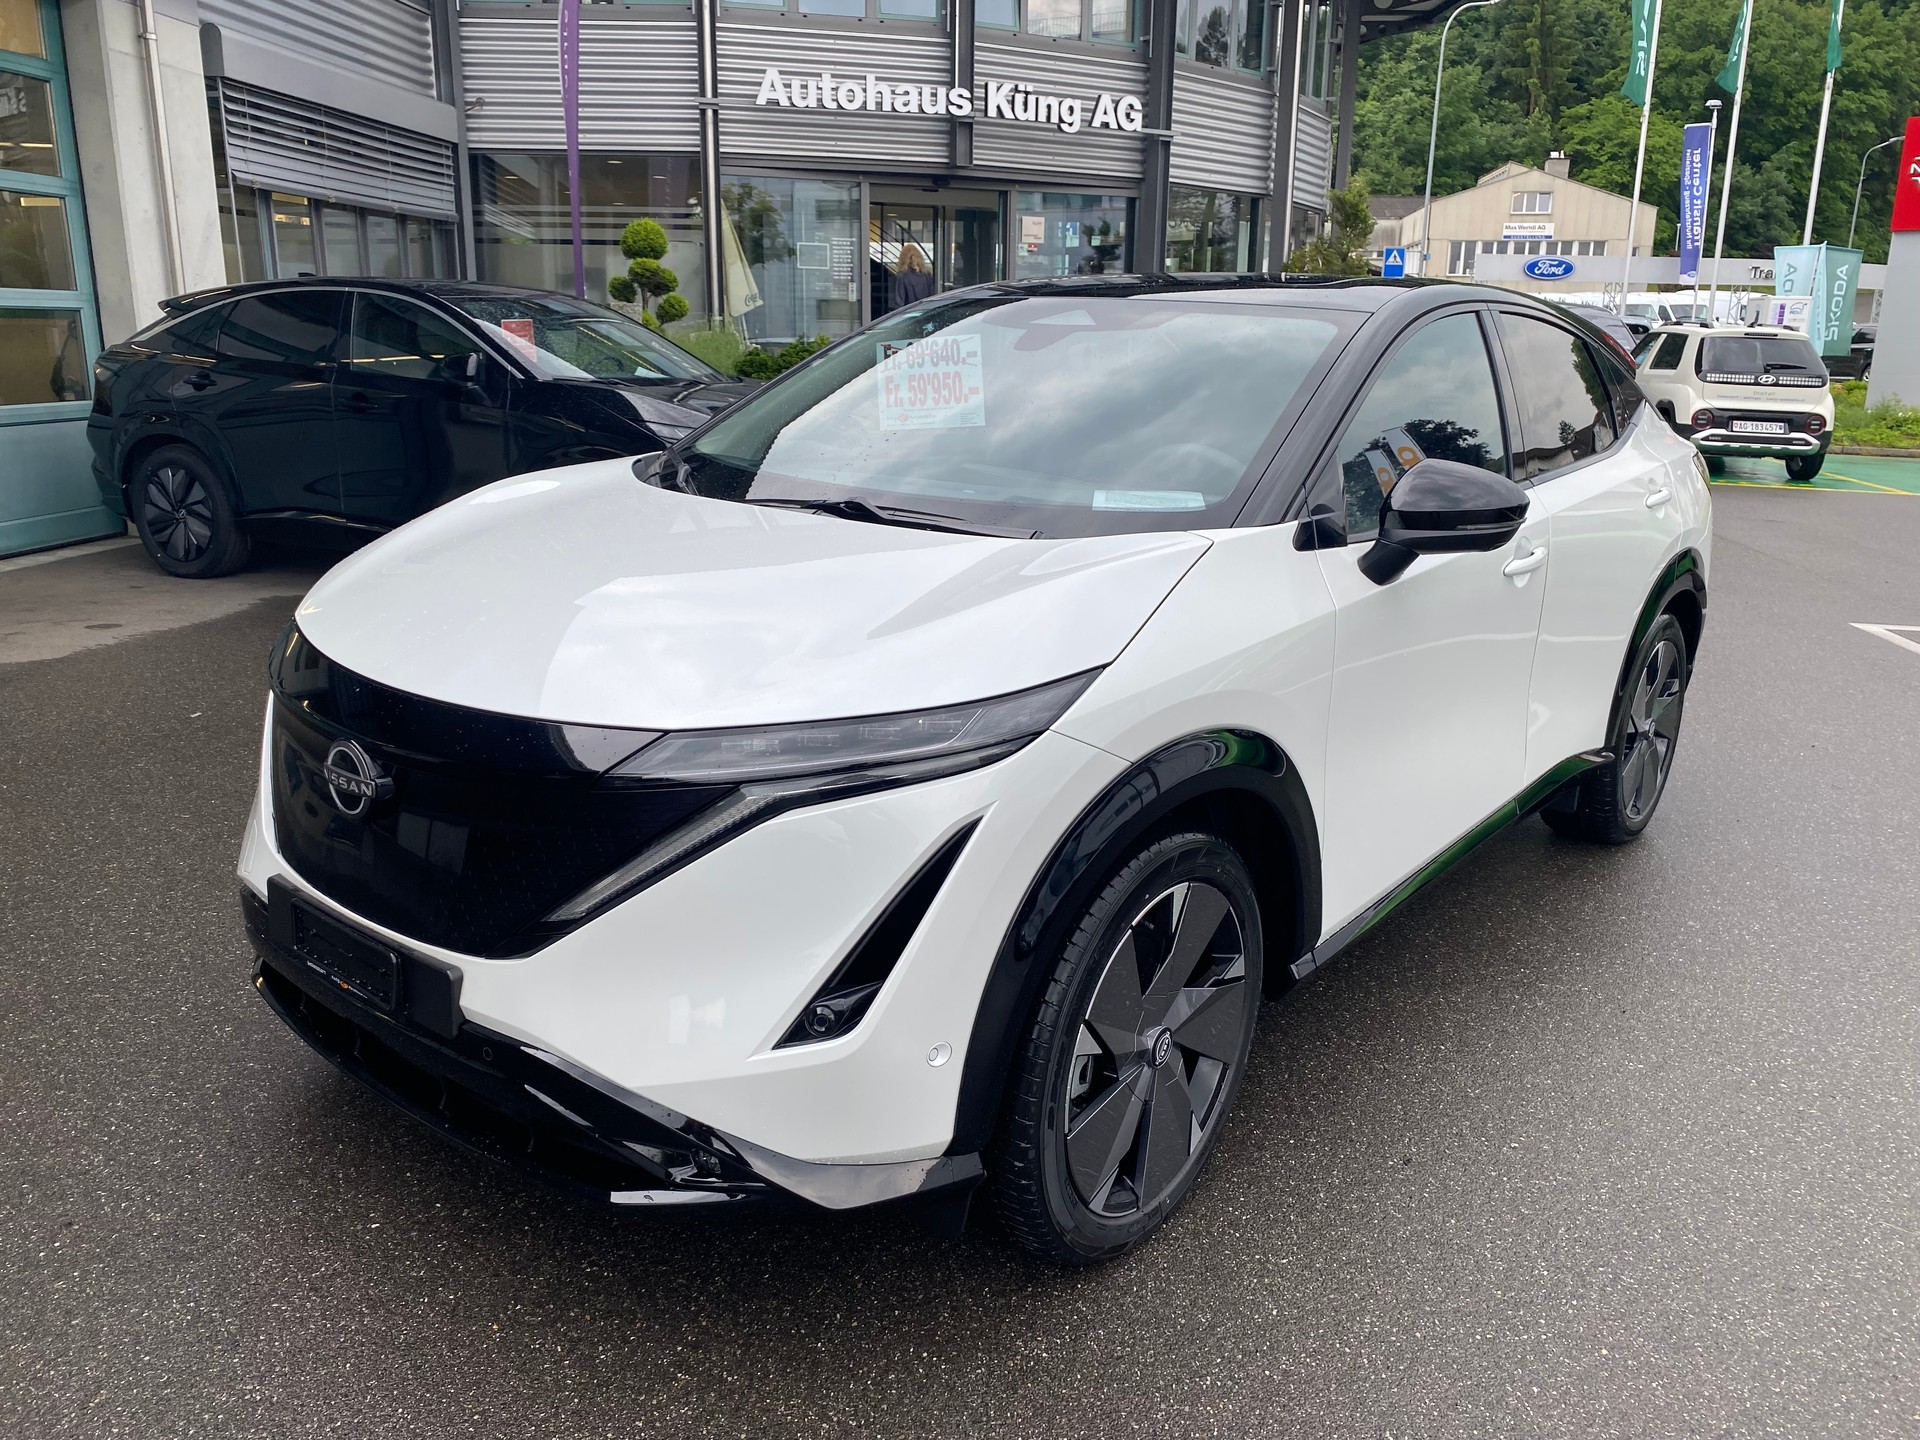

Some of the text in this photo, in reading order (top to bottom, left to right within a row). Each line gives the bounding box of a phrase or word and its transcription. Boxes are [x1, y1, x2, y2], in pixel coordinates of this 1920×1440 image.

[755, 68, 1144, 133] Autohaus Küng AG
[1534, 260, 1566, 275] Ford
[1750, 265, 1776, 280] Tra
[882, 343, 902, 370] Fr.
[884, 375, 904, 407] Fr.
[324, 768, 373, 797] NISSAN
